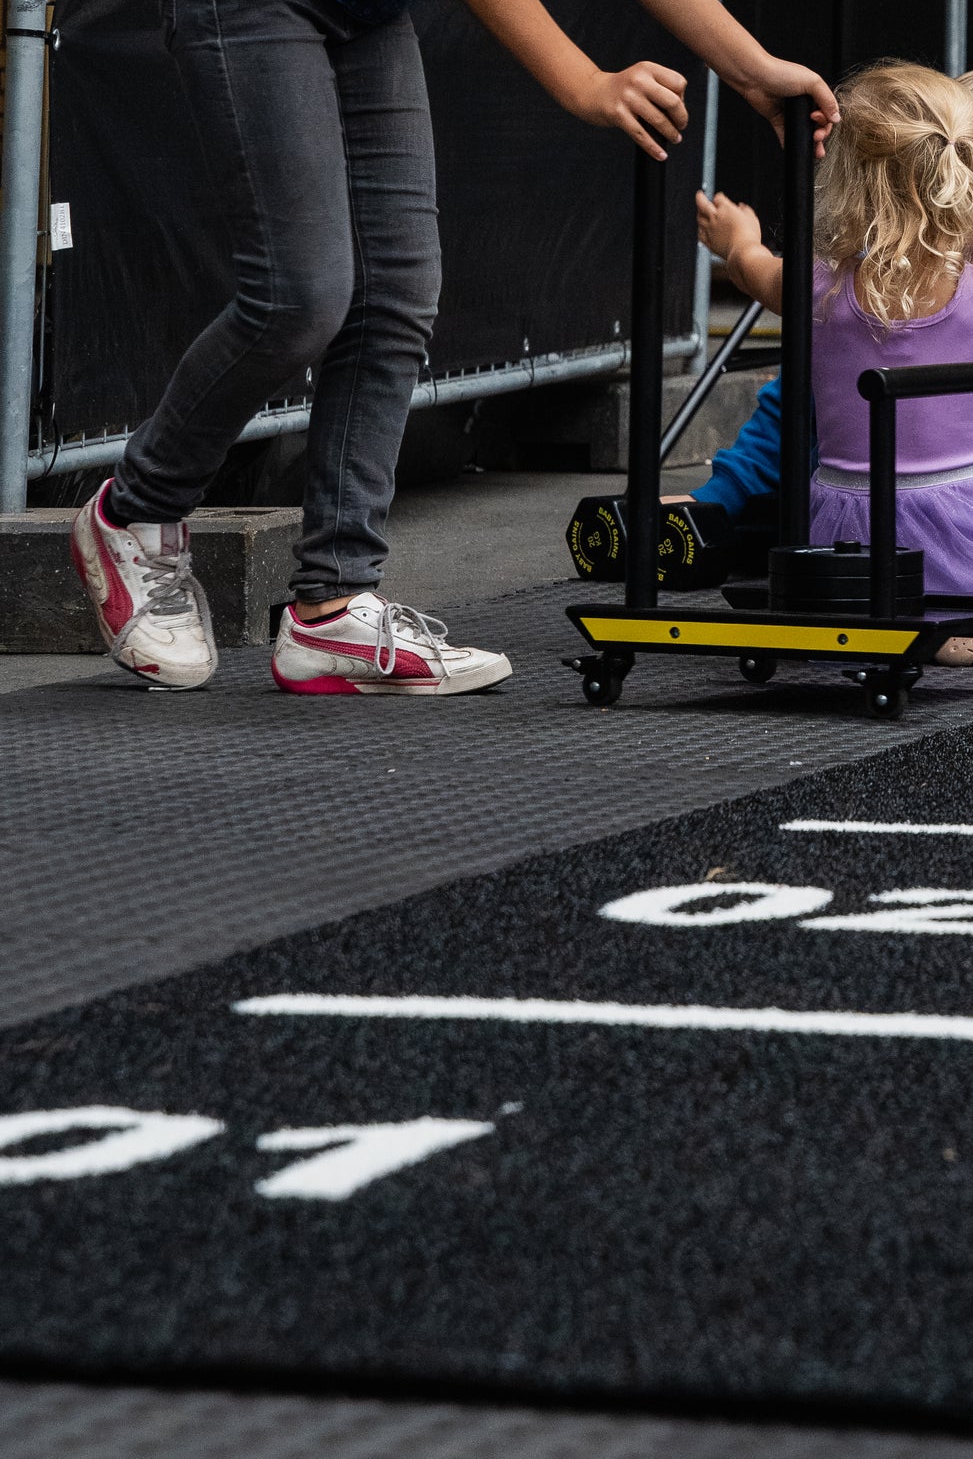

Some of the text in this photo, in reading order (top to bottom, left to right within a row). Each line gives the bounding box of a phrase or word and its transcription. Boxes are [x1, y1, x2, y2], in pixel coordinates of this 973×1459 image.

[571, 520, 592, 573] BABY GAINS
[598, 507, 619, 559] BABY GAINS
[668, 513, 695, 565] BABY GAINS
[0, 1105, 495, 1202] 01
